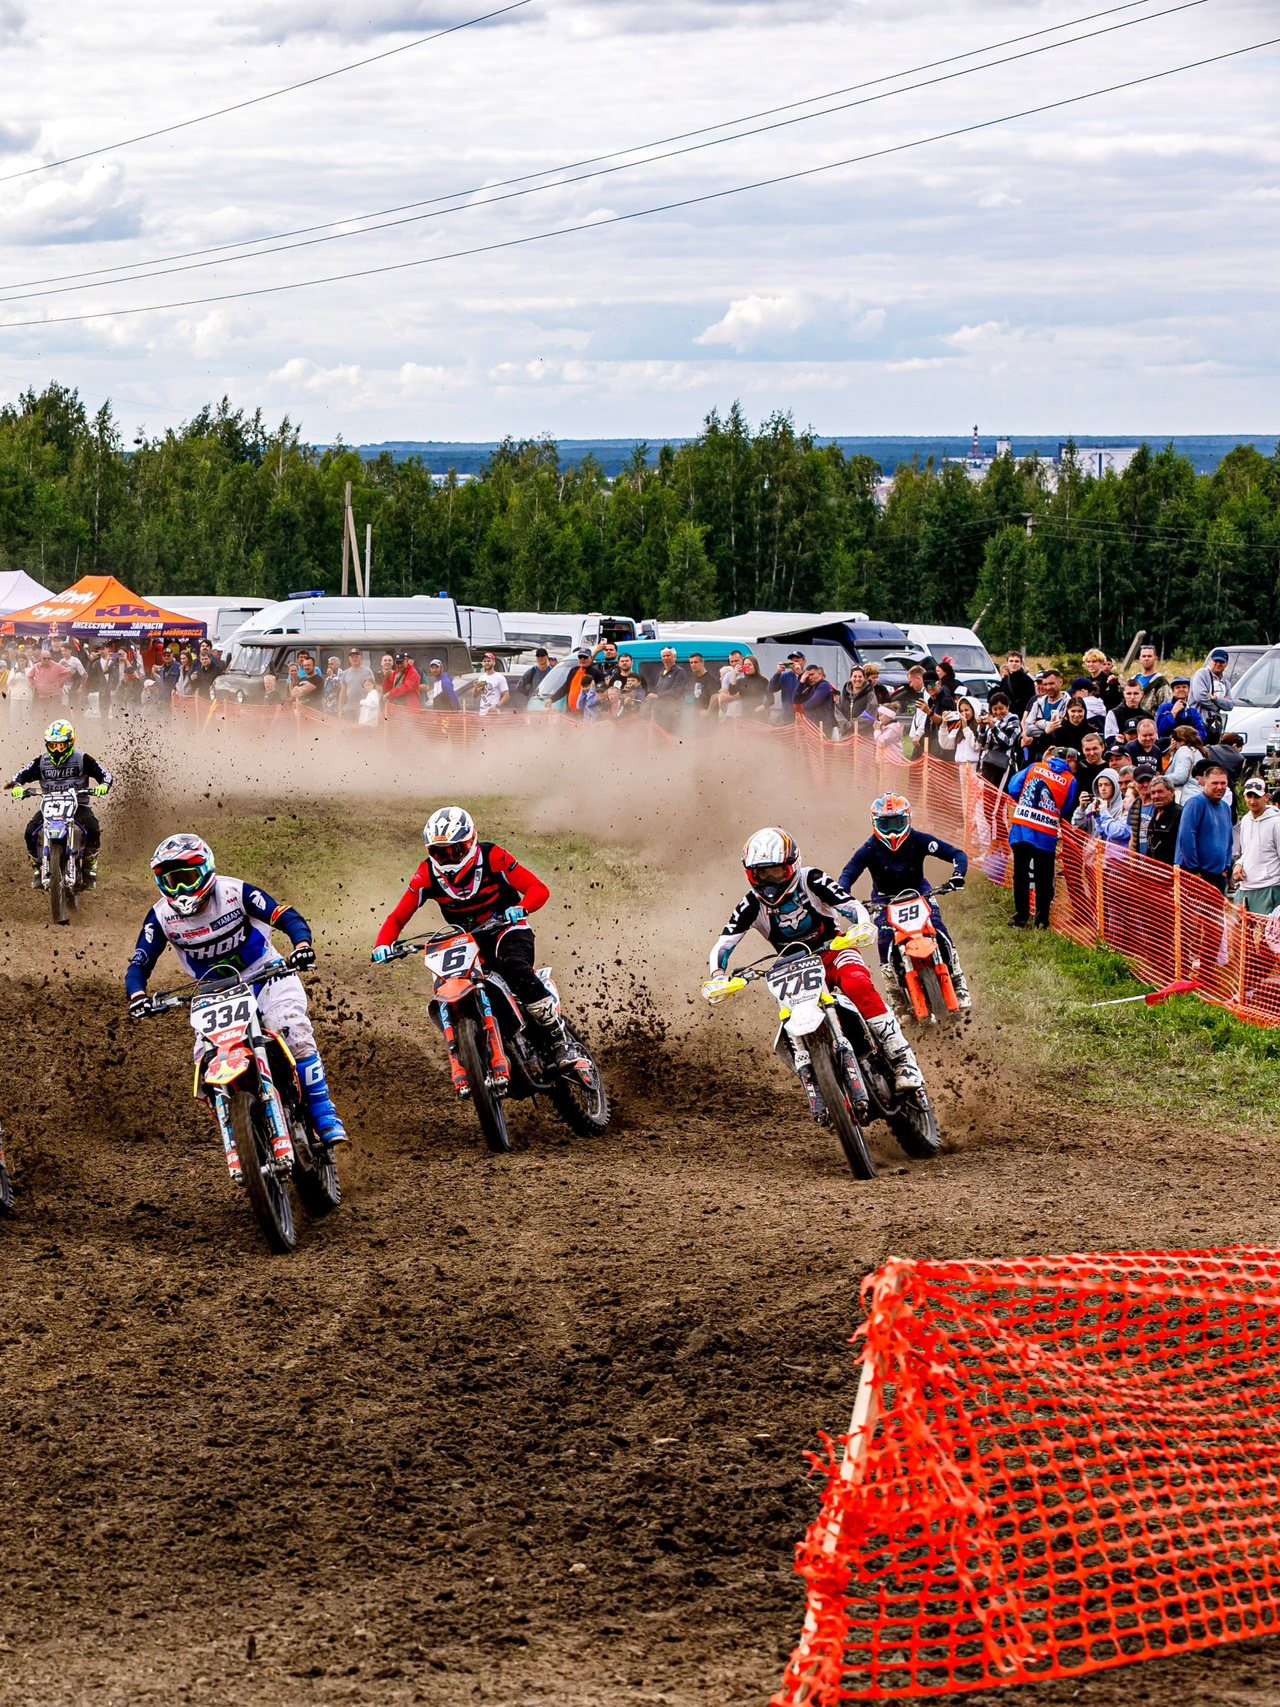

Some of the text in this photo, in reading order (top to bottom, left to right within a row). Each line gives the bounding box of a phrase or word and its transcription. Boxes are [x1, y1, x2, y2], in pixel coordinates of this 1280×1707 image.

[95, 604, 160, 618] KTM
[130, 622, 164, 630] ЗАПЧАСТИ
[44, 769, 61, 779] TROY
[61, 767, 74, 778] LEE
[1034, 767, 1067, 785] RUSSIA
[898, 904, 919, 924] 59
[183, 926, 247, 960] THOR
[441, 945, 467, 972] 6
[772, 967, 823, 1000] 776
[202, 1000, 250, 1033] 334
[216, 1029, 242, 1043] KTM
